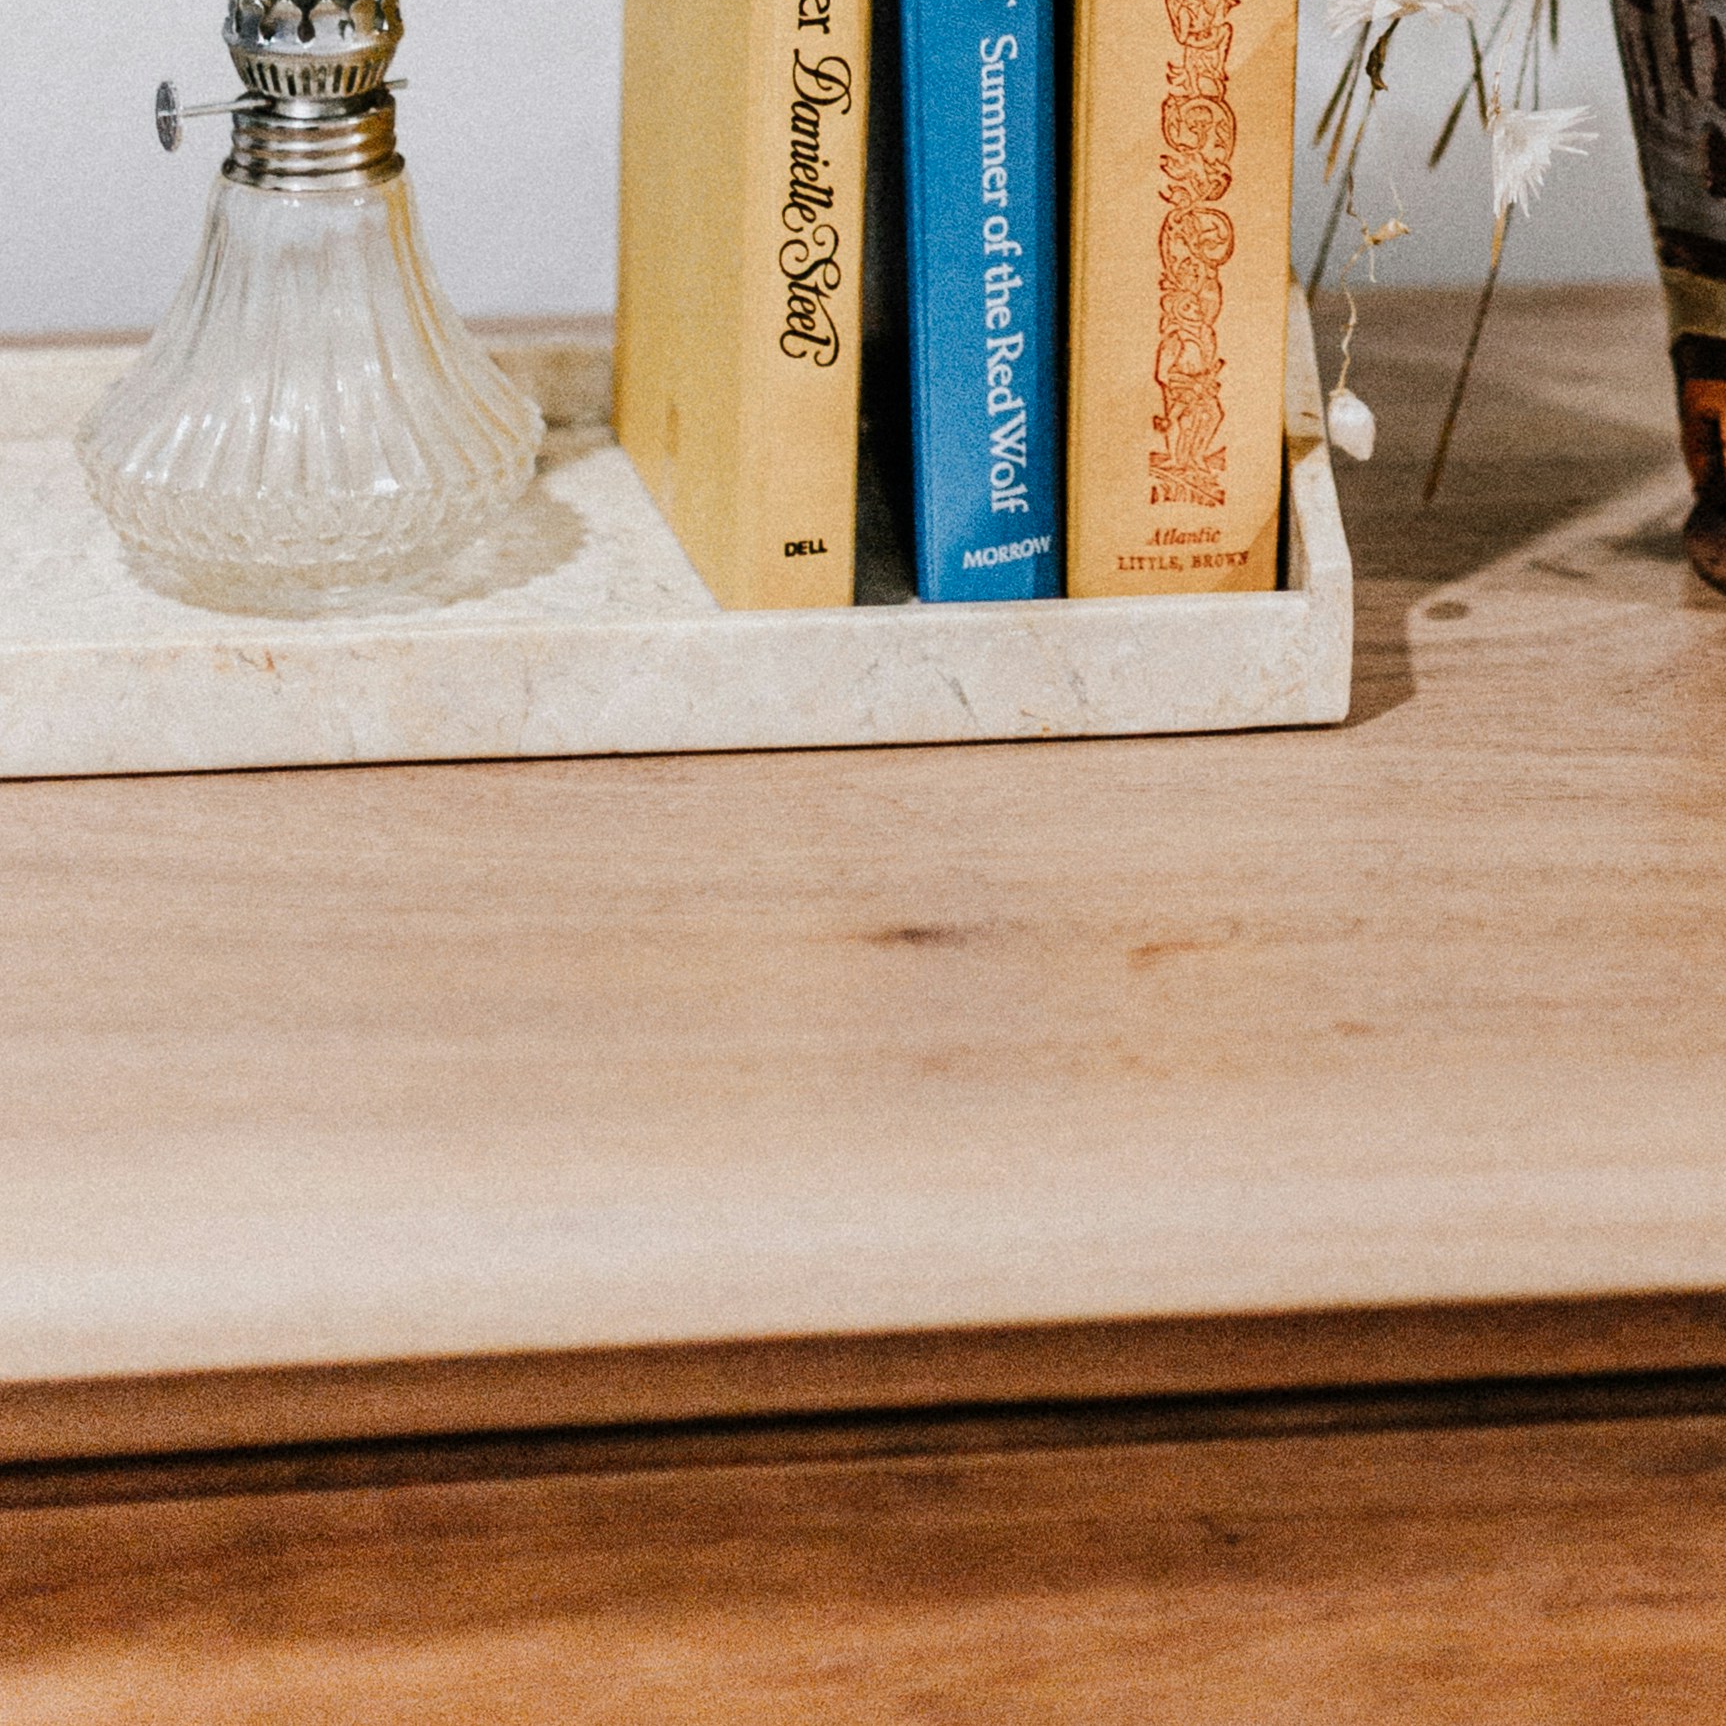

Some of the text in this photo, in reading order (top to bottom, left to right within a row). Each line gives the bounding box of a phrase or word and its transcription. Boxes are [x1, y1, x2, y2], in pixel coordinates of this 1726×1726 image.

[779, 48, 852, 368] Danielle Steel
[979, 34, 1029, 514] Summer of the Red Wolf
[784, 539, 828, 558] DELL
[1146, 526, 1221, 546] Atlantic
[962, 534, 1051, 570] MORROW
[1116, 550, 1249, 572] LITTLE, BROWN
